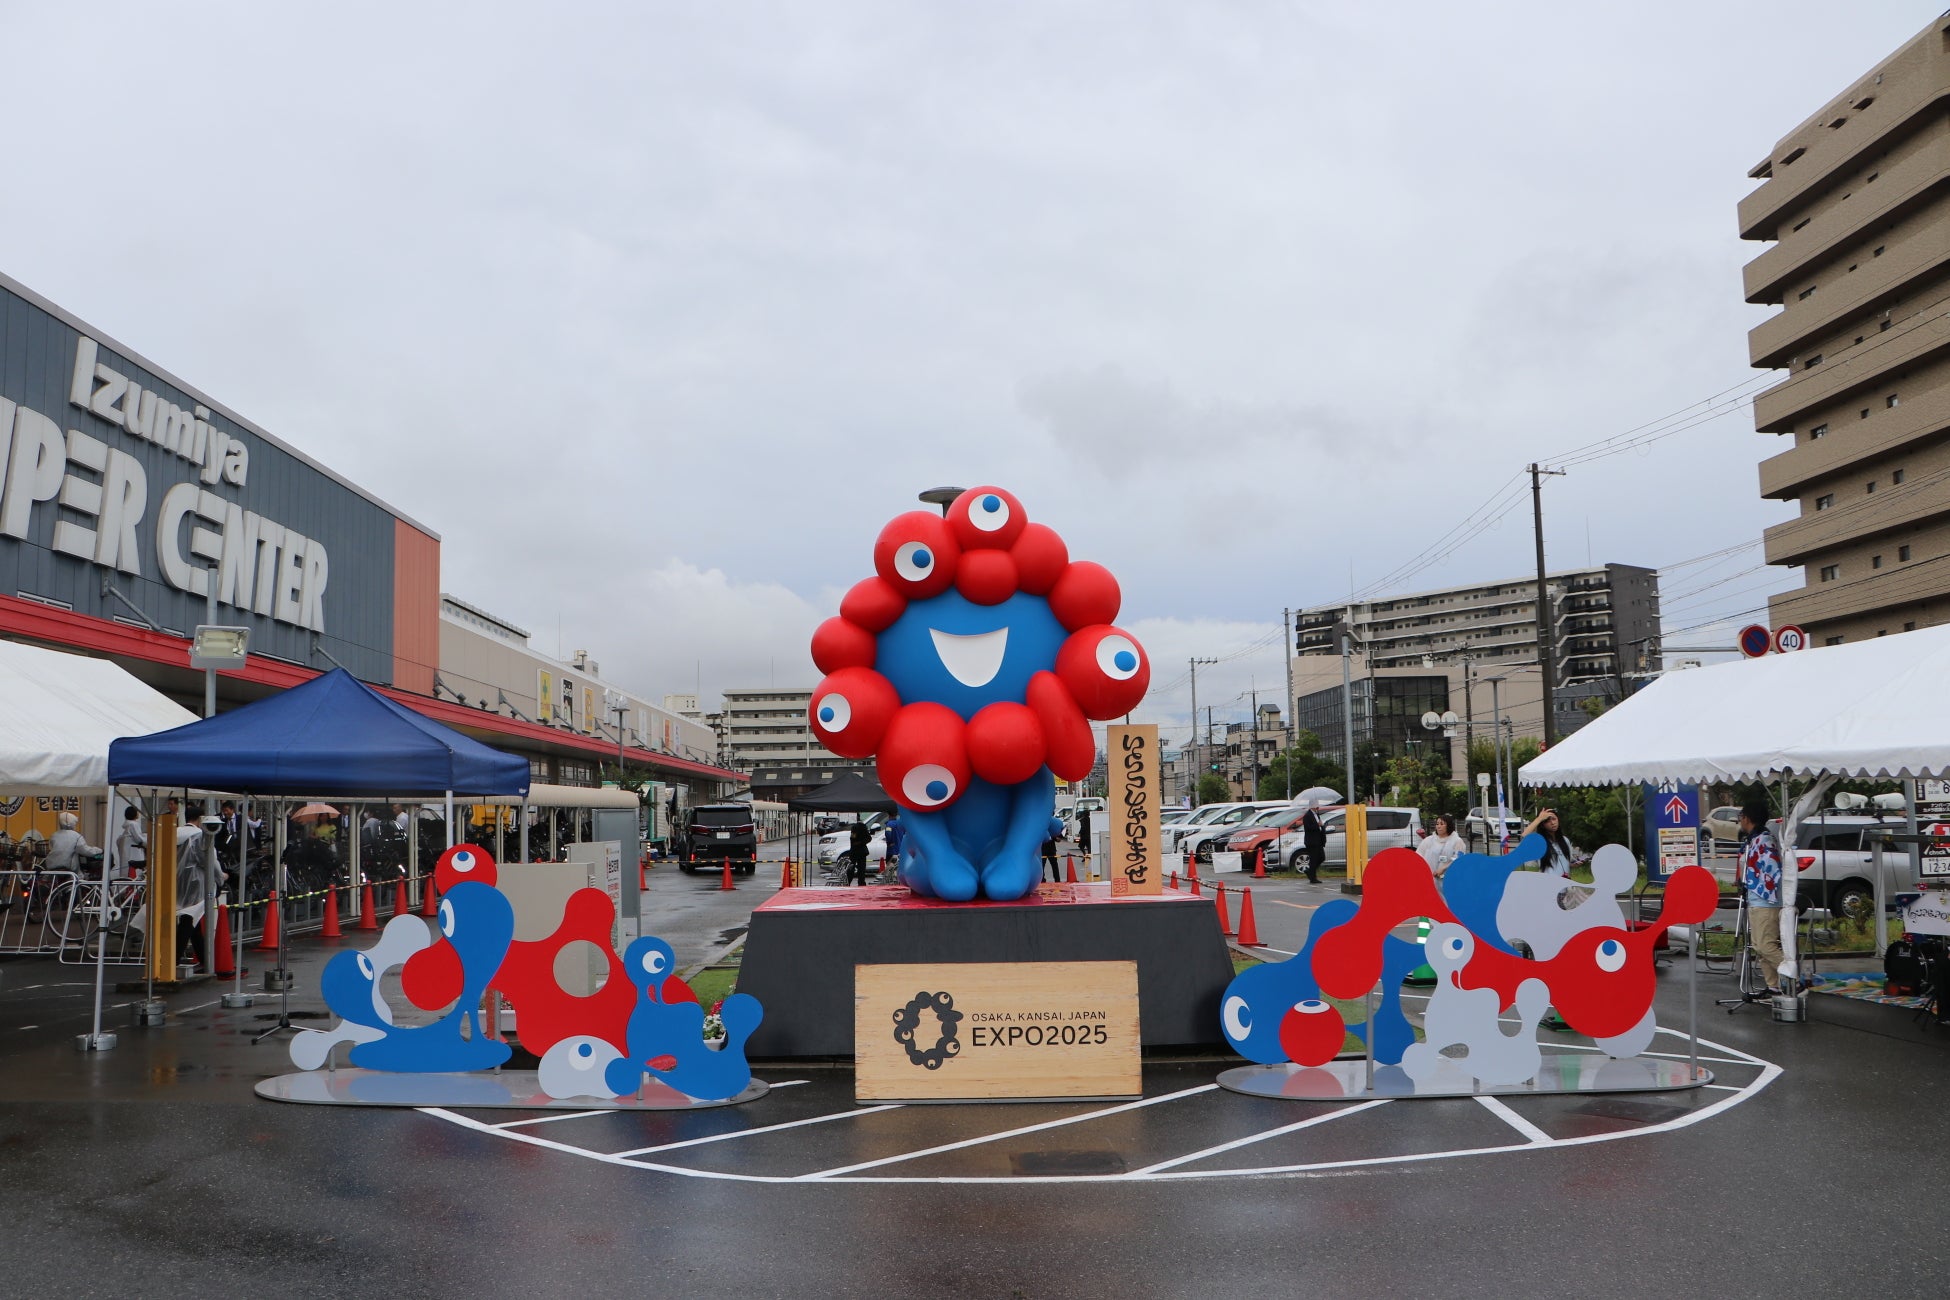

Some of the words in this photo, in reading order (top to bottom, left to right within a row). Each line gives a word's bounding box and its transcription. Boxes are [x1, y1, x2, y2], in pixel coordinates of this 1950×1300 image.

[70, 336, 249, 487] Izumiya
[156, 482, 329, 634] CENTER
[1782, 634, 1798, 648] 40
[1658, 781, 1679, 794] IN
[971, 1012, 1015, 1022] OSAKA,
[1067, 1011, 1106, 1021] JAPAN
[971, 1024, 1108, 1047] EXPO2025
